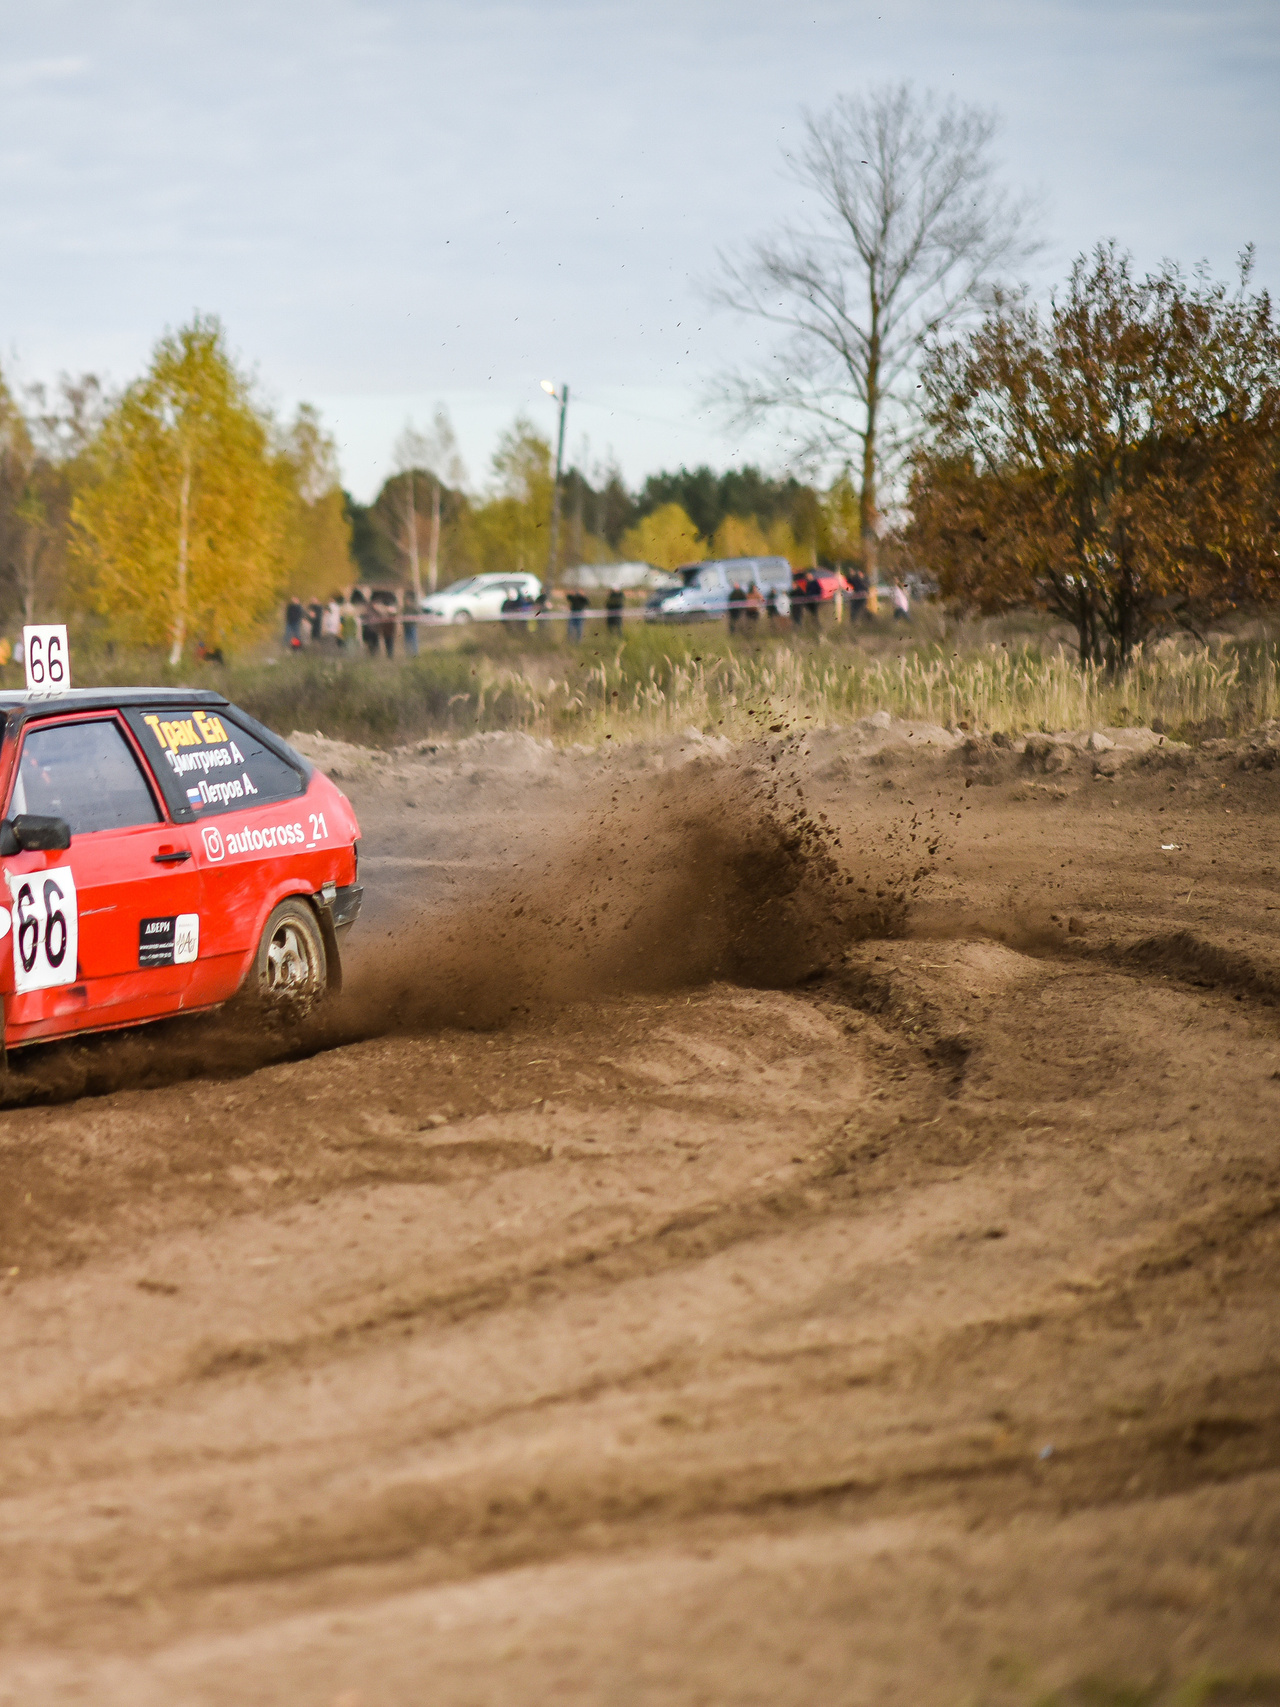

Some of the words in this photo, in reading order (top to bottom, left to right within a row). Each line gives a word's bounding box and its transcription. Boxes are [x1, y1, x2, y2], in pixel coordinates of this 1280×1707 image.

[30, 635, 64, 683] 66
[143, 715, 203, 754] Трак
[192, 711, 229, 744] Ен
[164, 748, 232, 777] Дмитриев
[230, 741, 245, 764] А
[198, 780, 244, 806] Петров
[242, 772, 258, 796] А.
[18, 879, 67, 973] 66
[145, 921, 170, 935] ДВЕРИ
